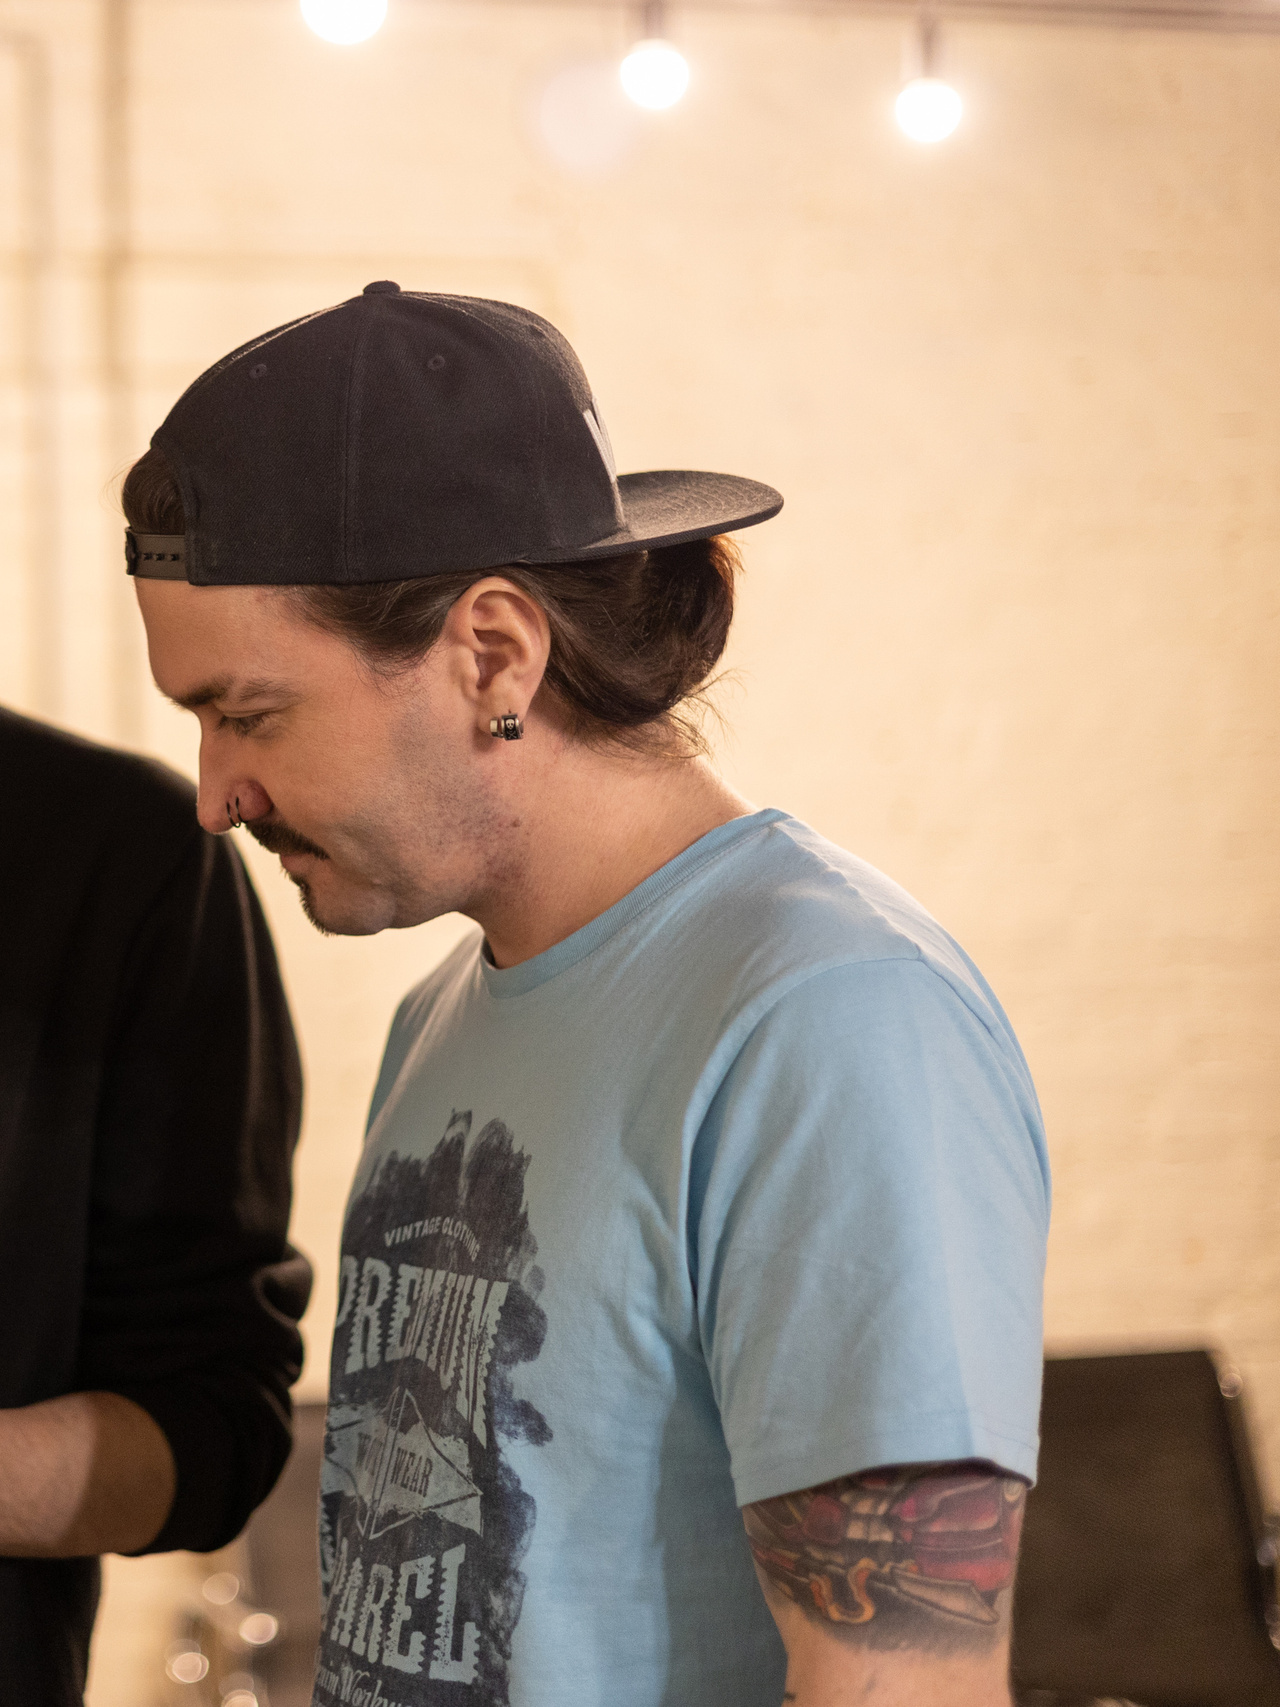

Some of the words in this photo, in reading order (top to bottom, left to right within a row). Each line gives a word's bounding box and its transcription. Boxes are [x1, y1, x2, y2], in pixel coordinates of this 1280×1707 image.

[384, 1216, 441, 1248] VINTAGE
[442, 1216, 480, 1262] CLOTHING
[391, 1446, 433, 1498] WEAR
